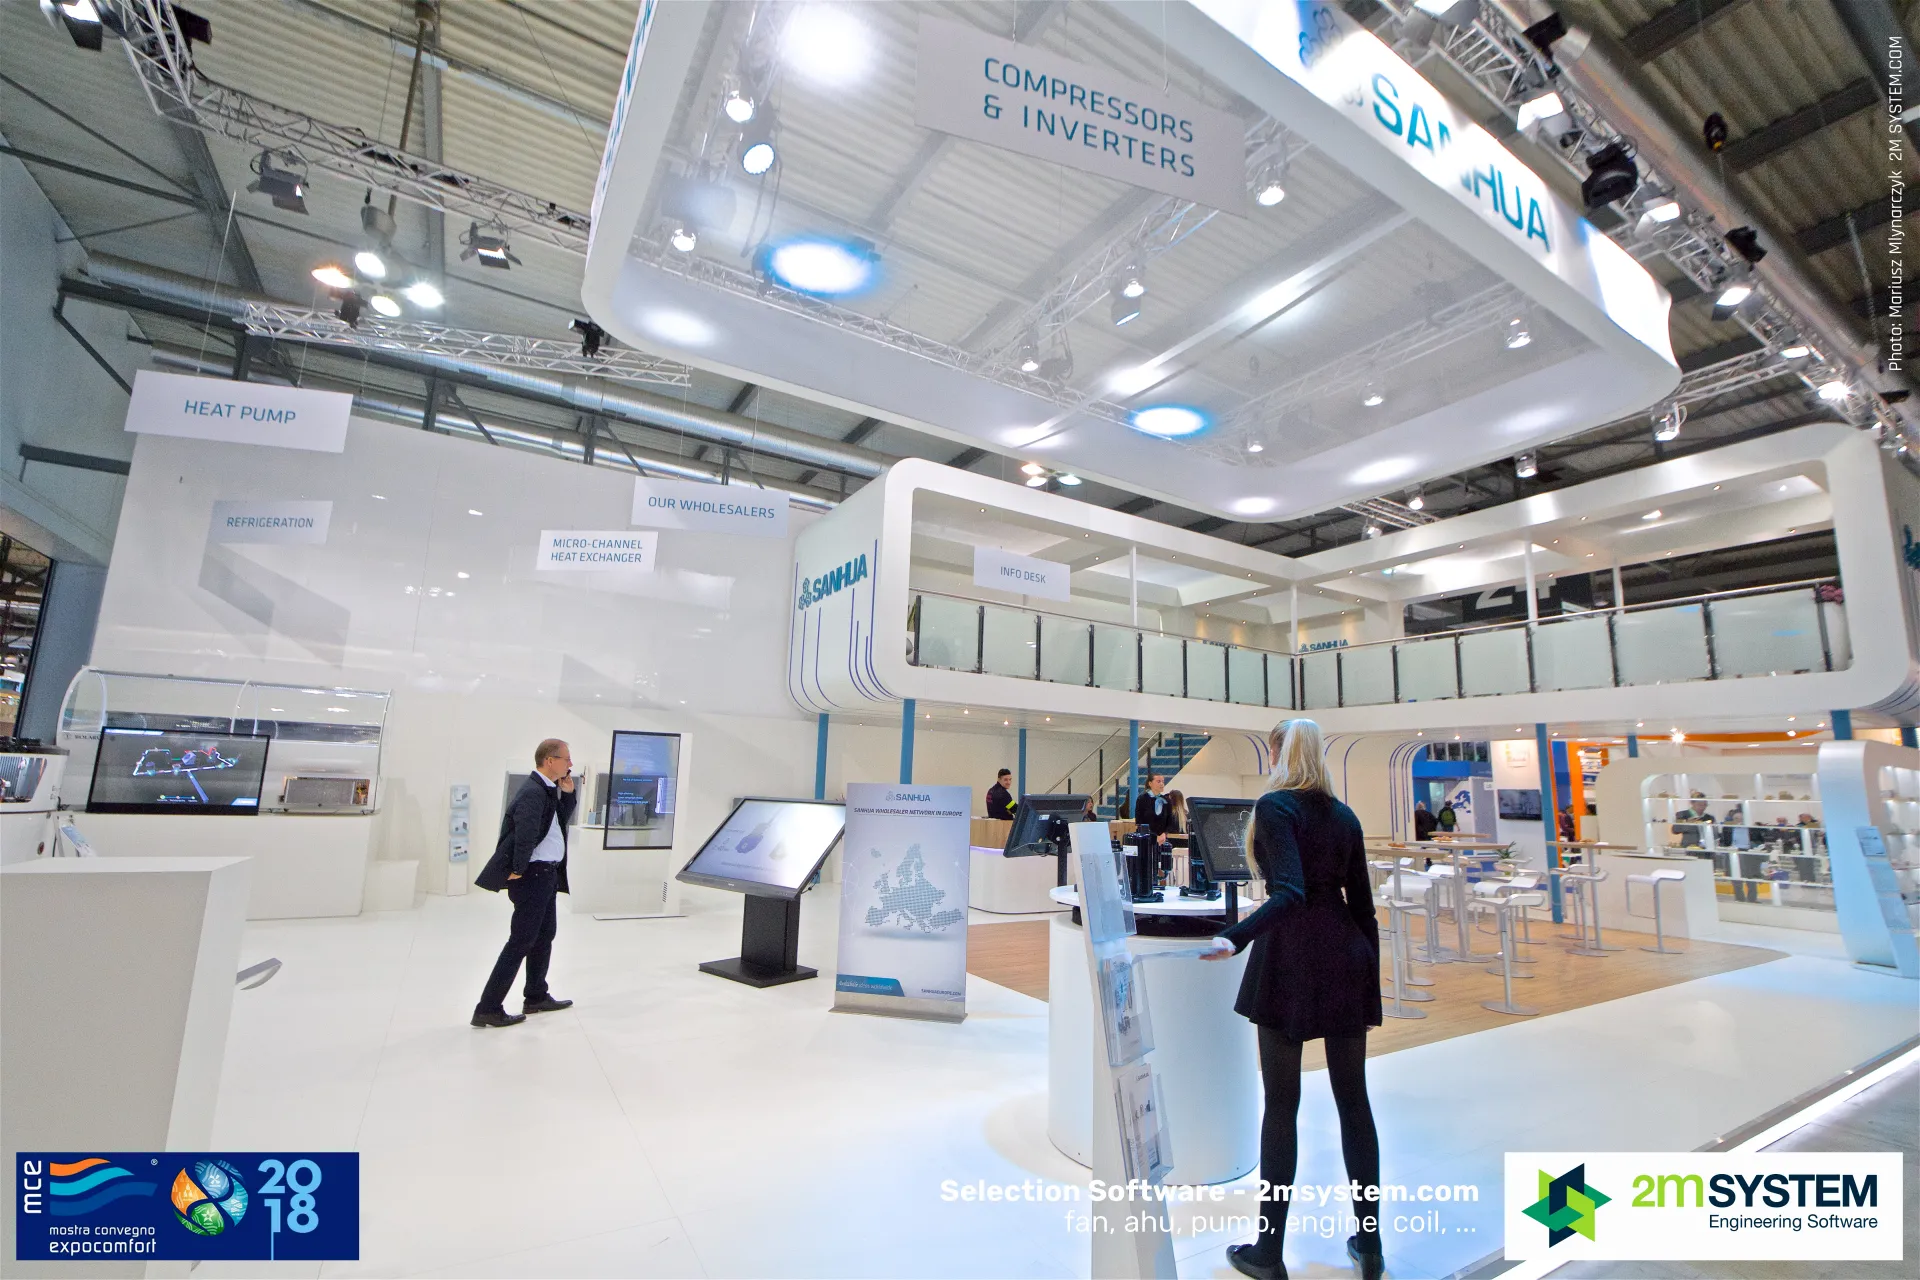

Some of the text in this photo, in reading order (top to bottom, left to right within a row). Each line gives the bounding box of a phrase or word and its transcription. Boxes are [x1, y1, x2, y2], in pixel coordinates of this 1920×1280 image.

[984, 57, 1194, 144] COMPRESSORS
[983, 94, 1195, 178] & INVERTERS
[183, 399, 297, 424] HEAT PUMP
[648, 496, 776, 519] OUR WHOLESALERS
[226, 516, 314, 529] REFRIGERATION
[552, 538, 643, 550] MICRO-CHANNEL
[550, 552, 642, 564] HEAT EXCHANGER
[812, 553, 868, 604] SANHUA
[1000, 565, 1046, 585] INFO DESK
[895, 793, 931, 802] SANHUA
